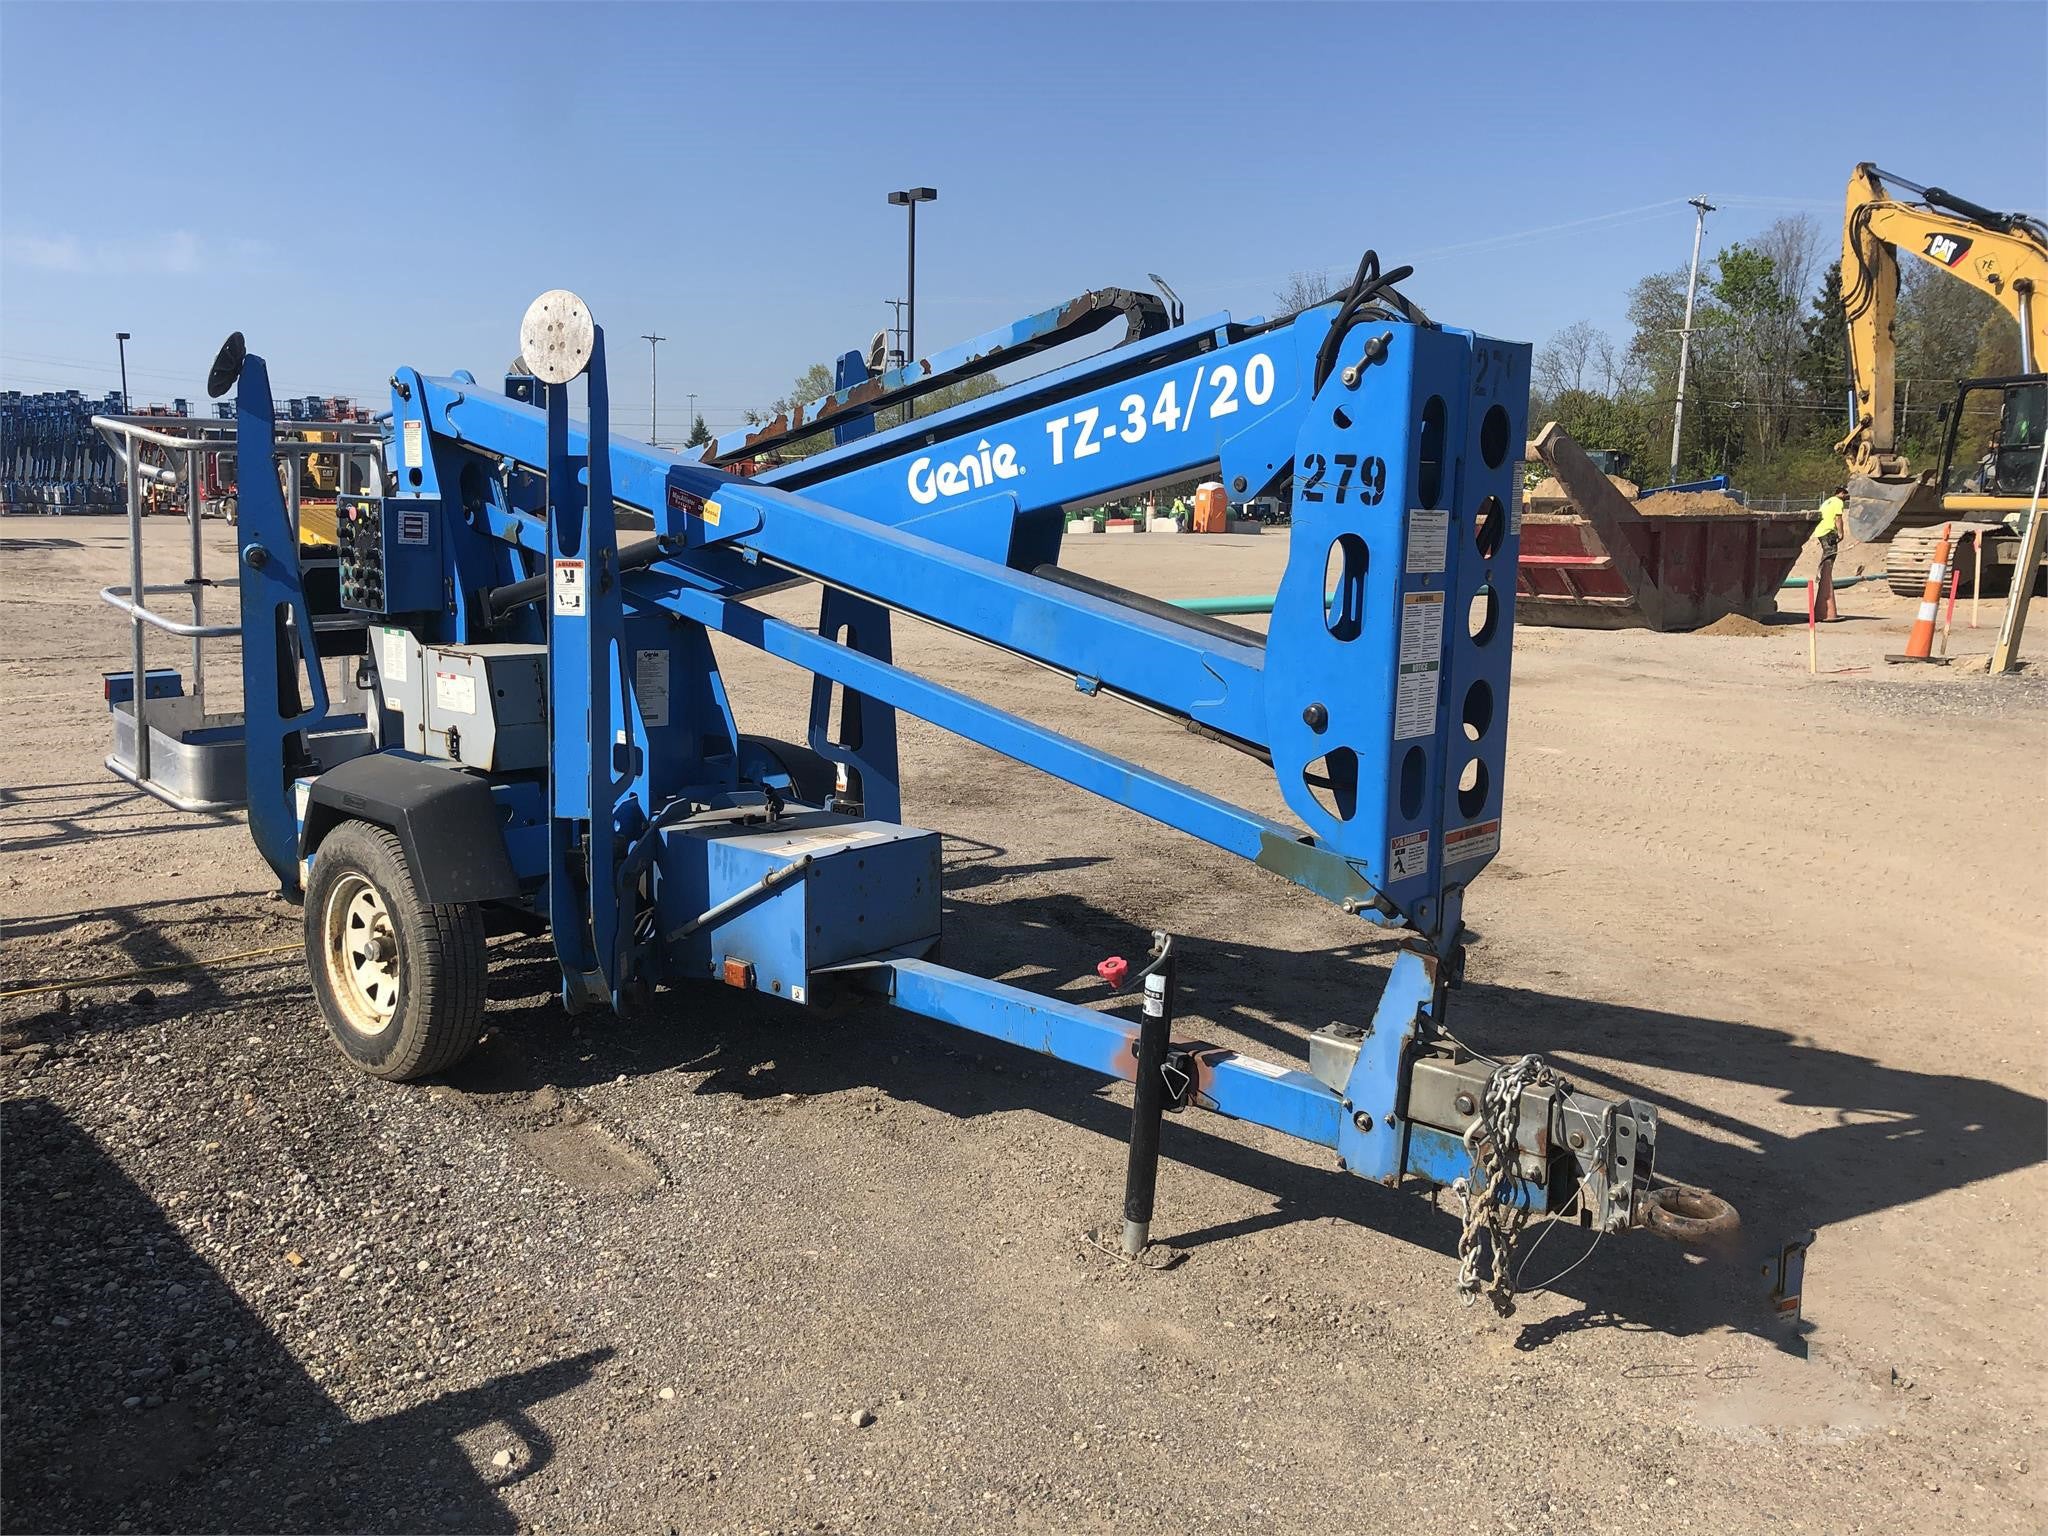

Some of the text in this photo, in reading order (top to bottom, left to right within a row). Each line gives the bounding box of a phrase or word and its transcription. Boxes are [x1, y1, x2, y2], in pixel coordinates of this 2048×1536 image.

[1930, 235, 1957, 263] CAT
[1046, 353, 1275, 465] TZ-34/20
[907, 438, 1019, 504] Genie
[1301, 453, 1386, 506] 279
[1412, 663, 1428, 672] NOTICE
